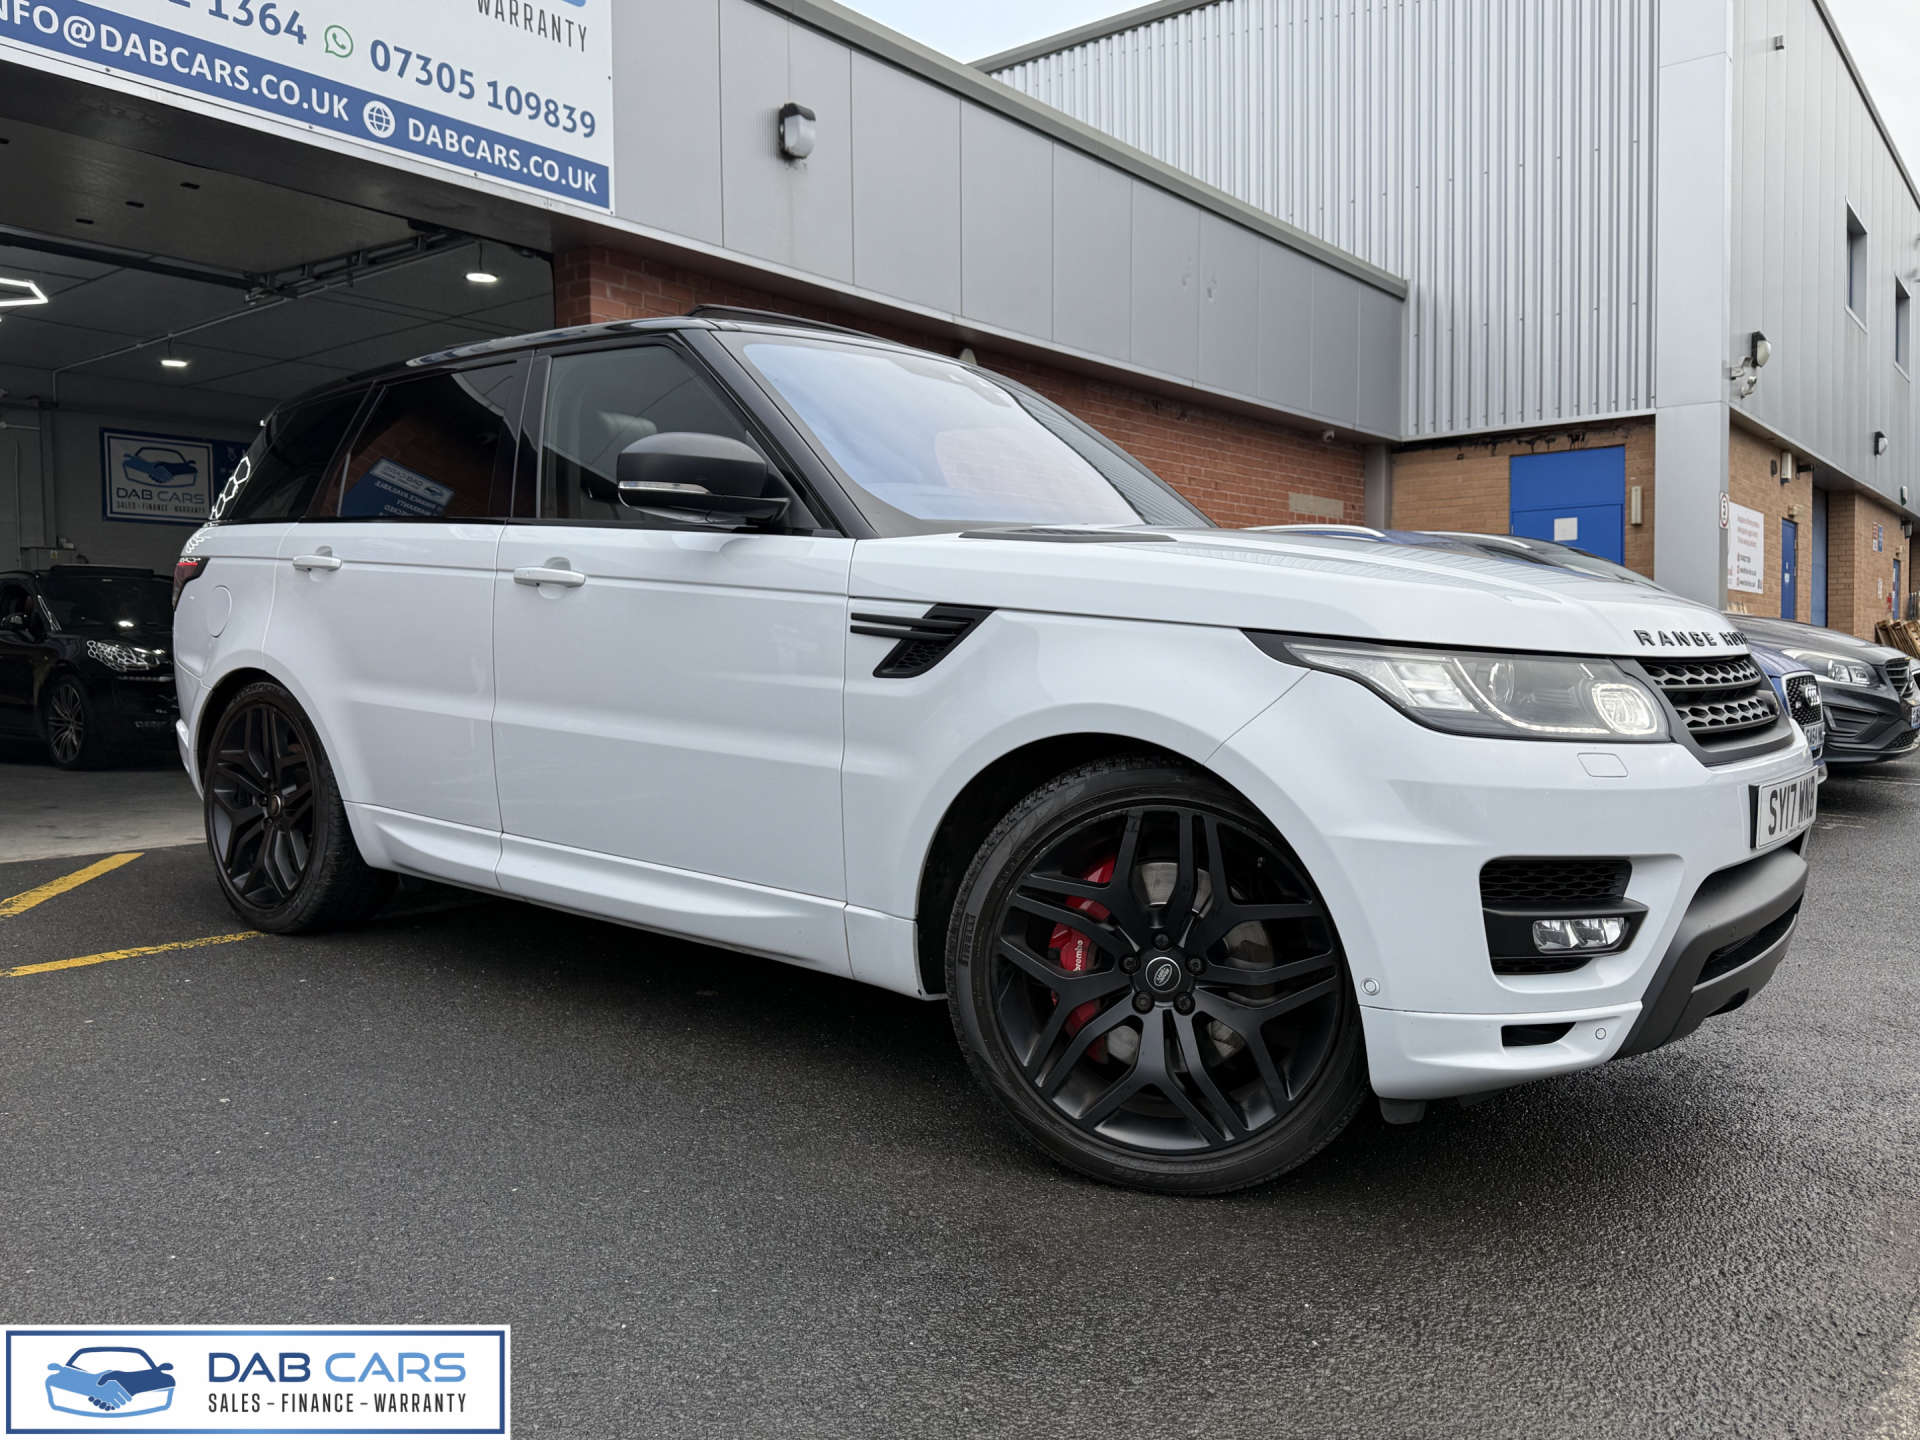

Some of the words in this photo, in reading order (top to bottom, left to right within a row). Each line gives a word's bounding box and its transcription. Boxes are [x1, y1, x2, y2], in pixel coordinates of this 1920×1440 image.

[370, 39, 475, 100] 07305
[487, 80, 596, 138] 109839
[408, 118, 597, 194] DABCARS.CO.UK
[117, 487, 153, 500] DAB
[157, 491, 205, 504] CARS
[1633, 629, 1717, 647] RANGE
